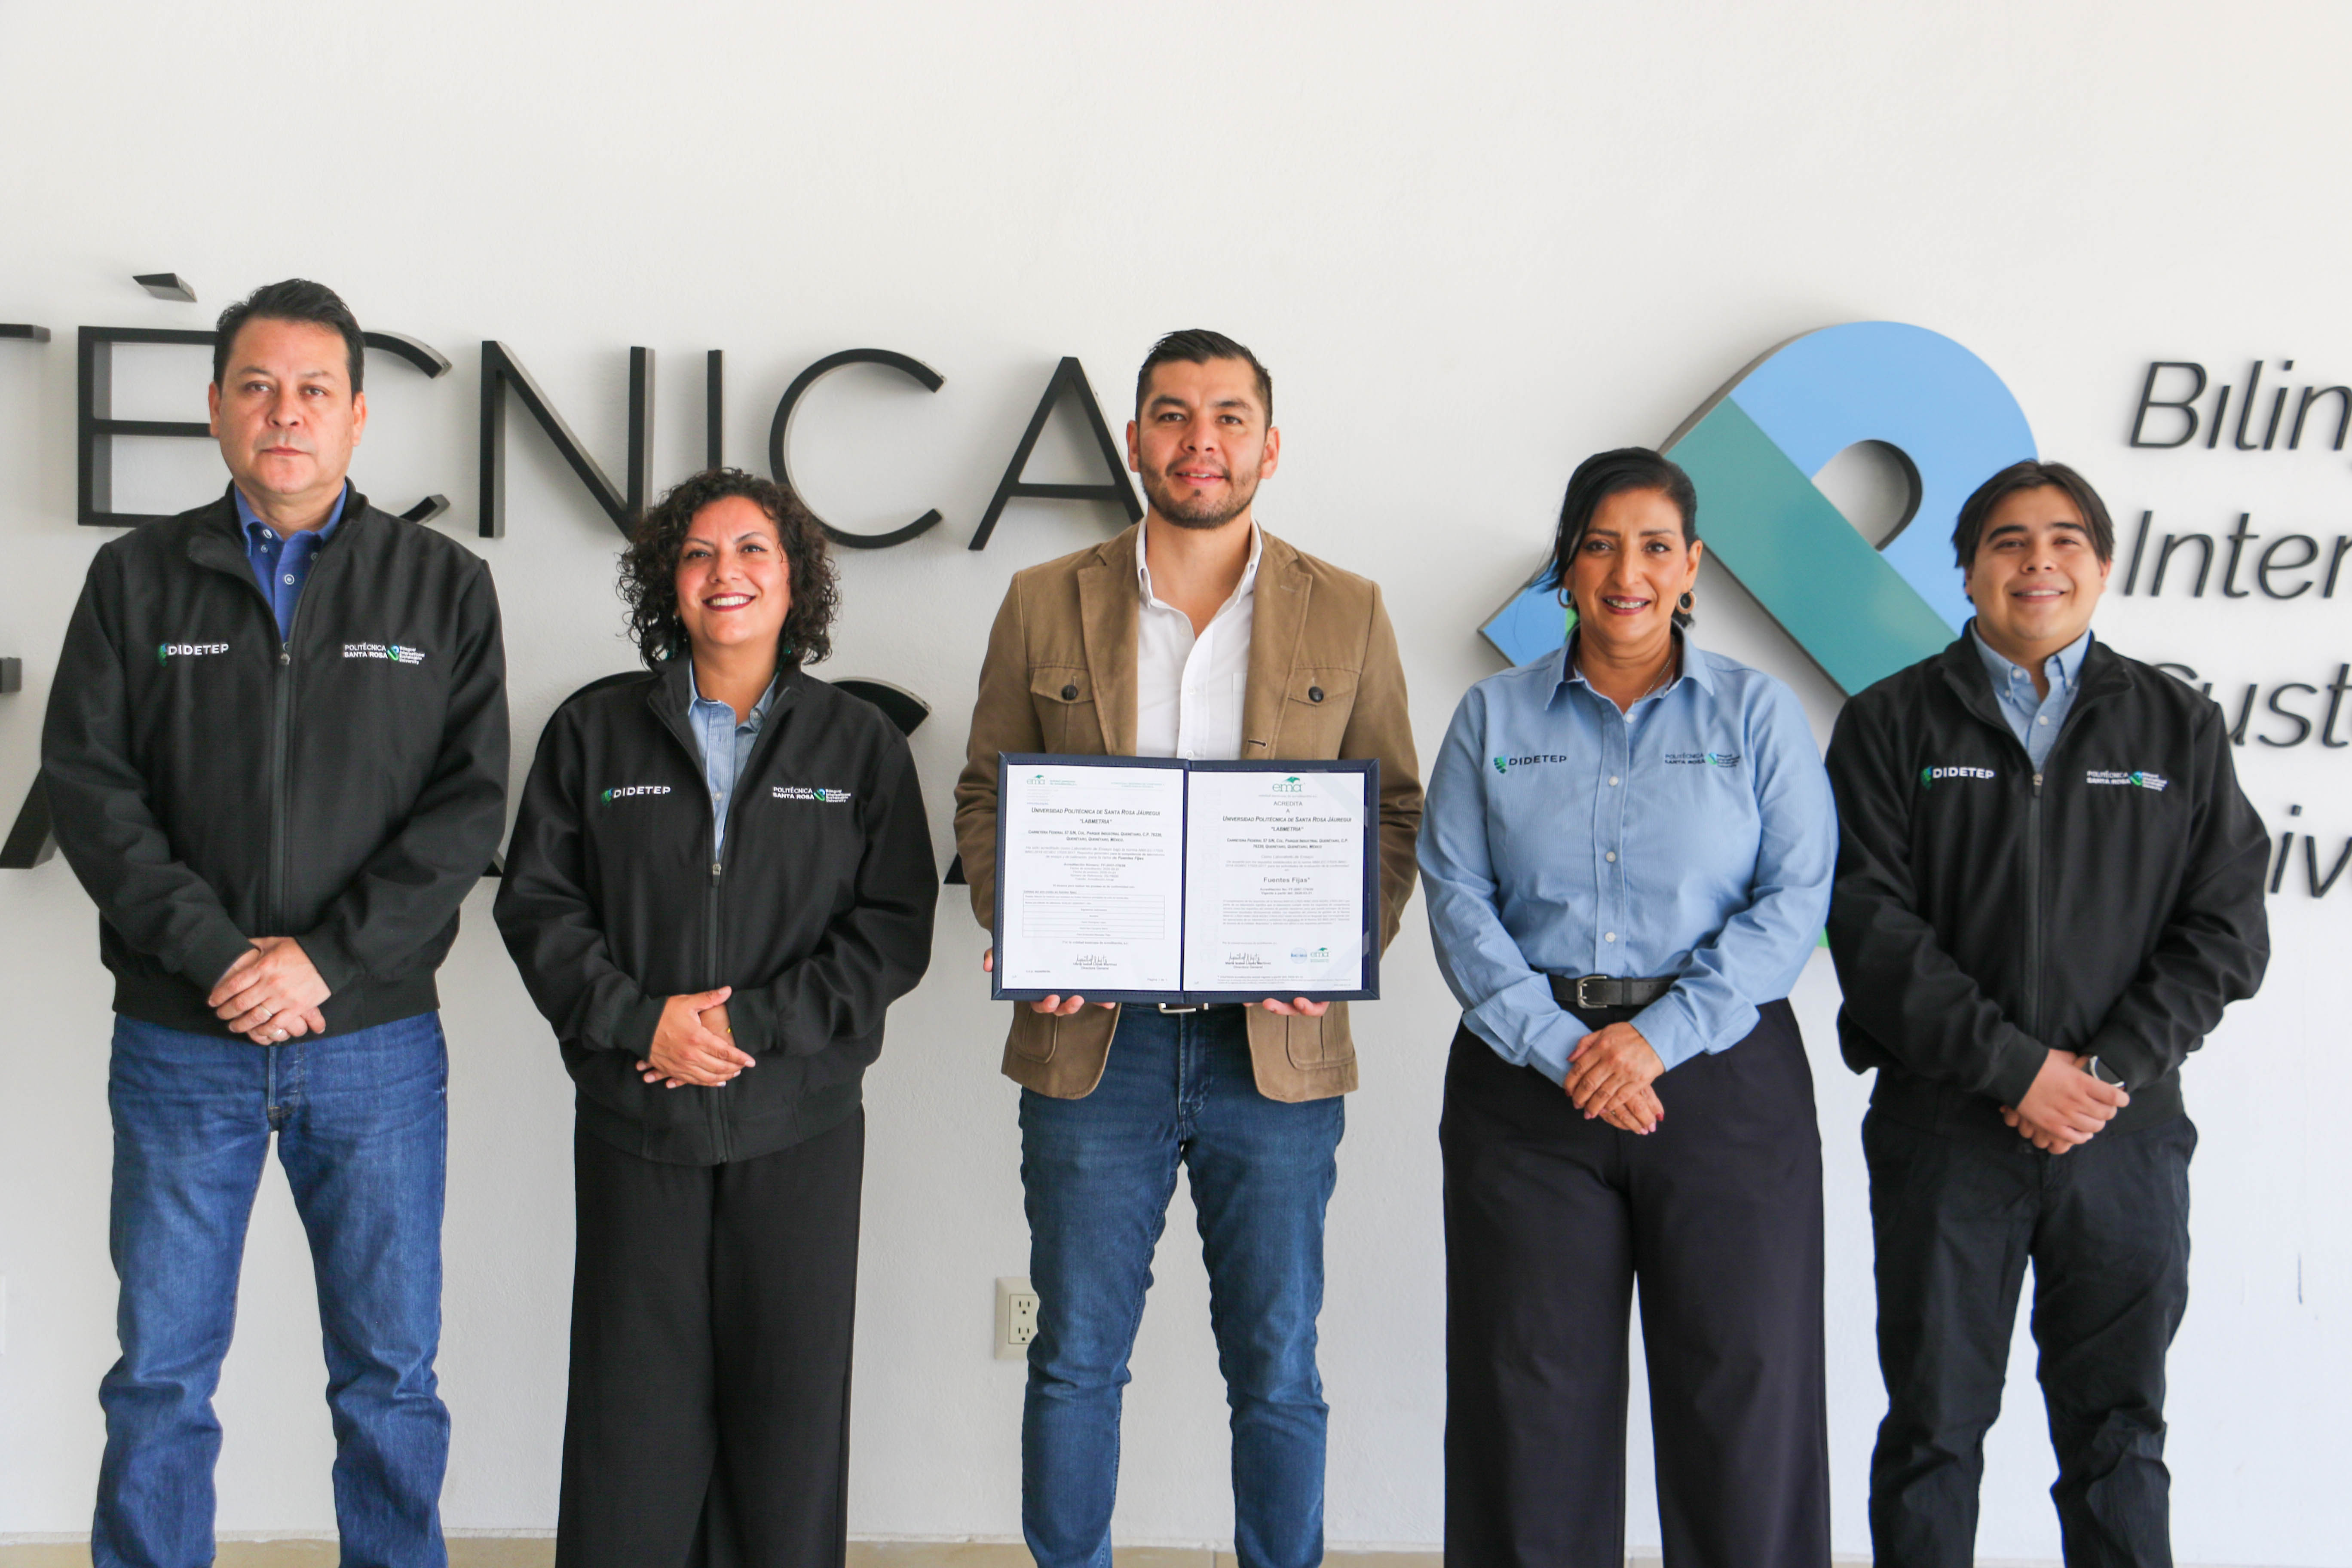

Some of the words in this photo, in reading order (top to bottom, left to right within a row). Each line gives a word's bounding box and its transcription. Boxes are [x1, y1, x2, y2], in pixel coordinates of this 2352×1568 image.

[2124, 510, 2352, 600] Inter
[168, 643, 229, 655] DIDETEP
[345, 642, 386, 652] POLITÉCNICA
[2153, 663, 2352, 748] ust
[1509, 754, 1567, 766] DIDETEP
[1932, 767, 1994, 779] DIDETEP
[613, 786, 671, 799] DIDETEP
[1272, 784, 1302, 792] ema
